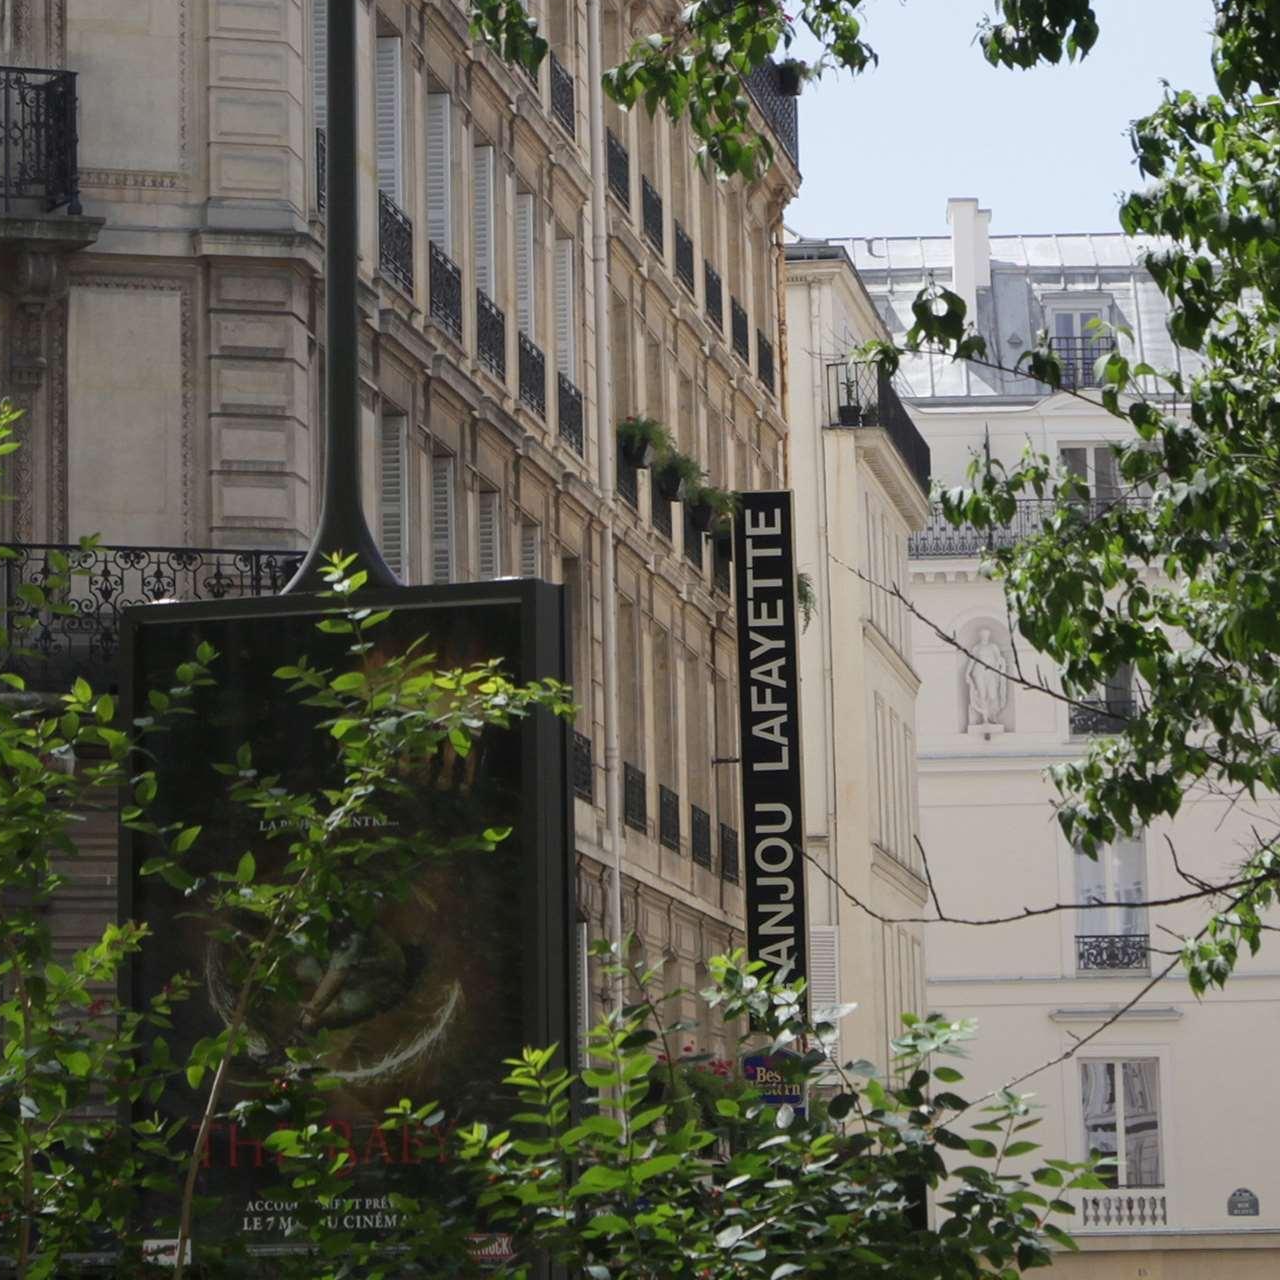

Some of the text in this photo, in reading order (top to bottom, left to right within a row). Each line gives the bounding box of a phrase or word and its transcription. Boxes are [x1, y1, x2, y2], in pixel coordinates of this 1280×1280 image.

[745, 507, 796, 977] ANJOU LAFAYETTE
[756, 1066, 785, 1083] Bes
[243, 1216, 263, 1231] LE
[265, 1217, 274, 1231] 7
